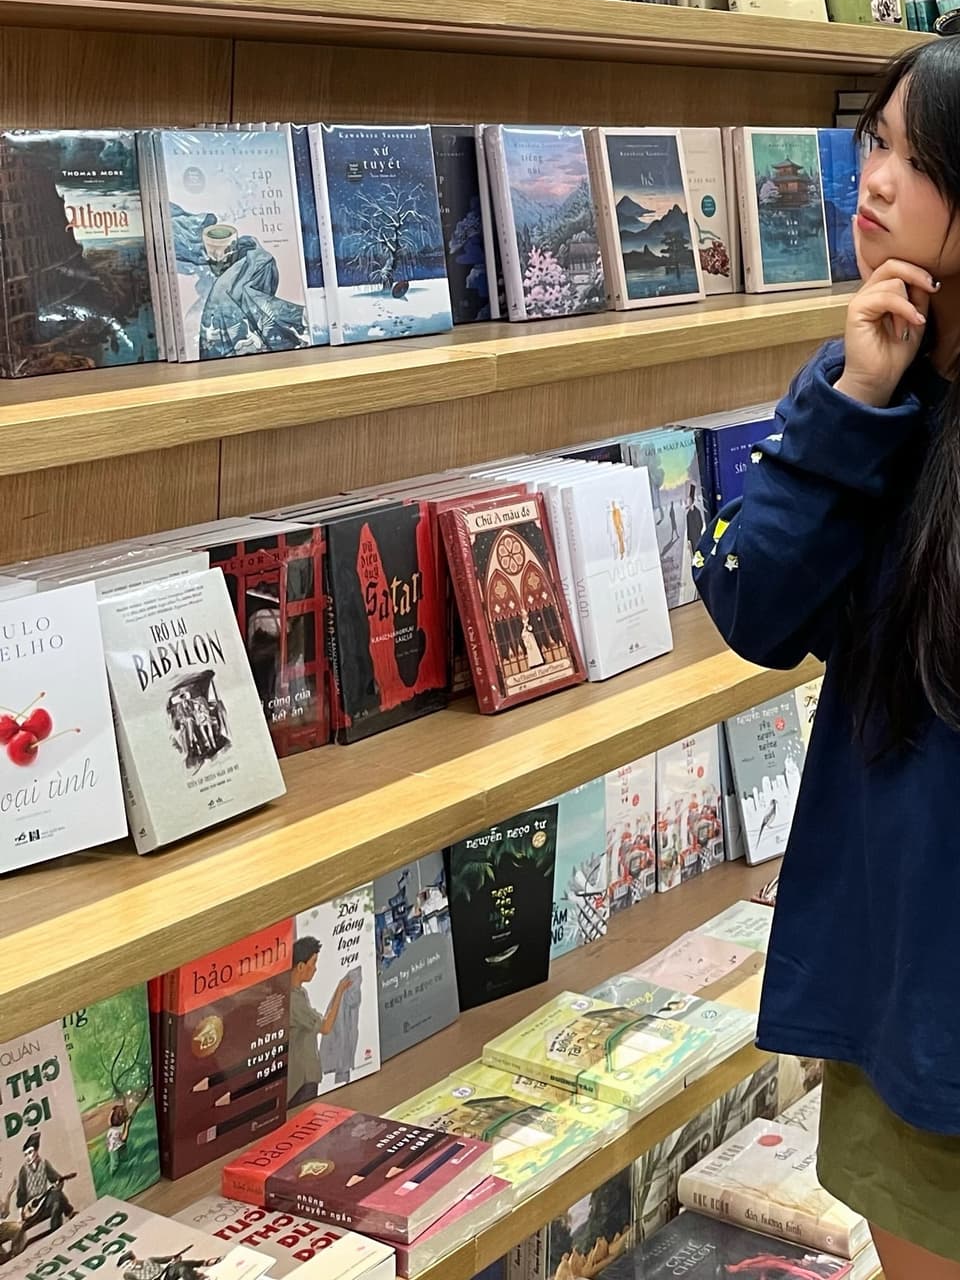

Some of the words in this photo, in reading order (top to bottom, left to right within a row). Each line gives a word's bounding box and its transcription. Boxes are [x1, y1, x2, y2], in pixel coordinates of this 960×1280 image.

[222, 556, 264, 571] ICTOR
[1, 615, 51, 641] ULO
[0, 634, 64, 663] ELHO
[132, 629, 227, 693] BABYLON
[192, 961, 234, 996] bảo
[238, 937, 288, 978] ninh
